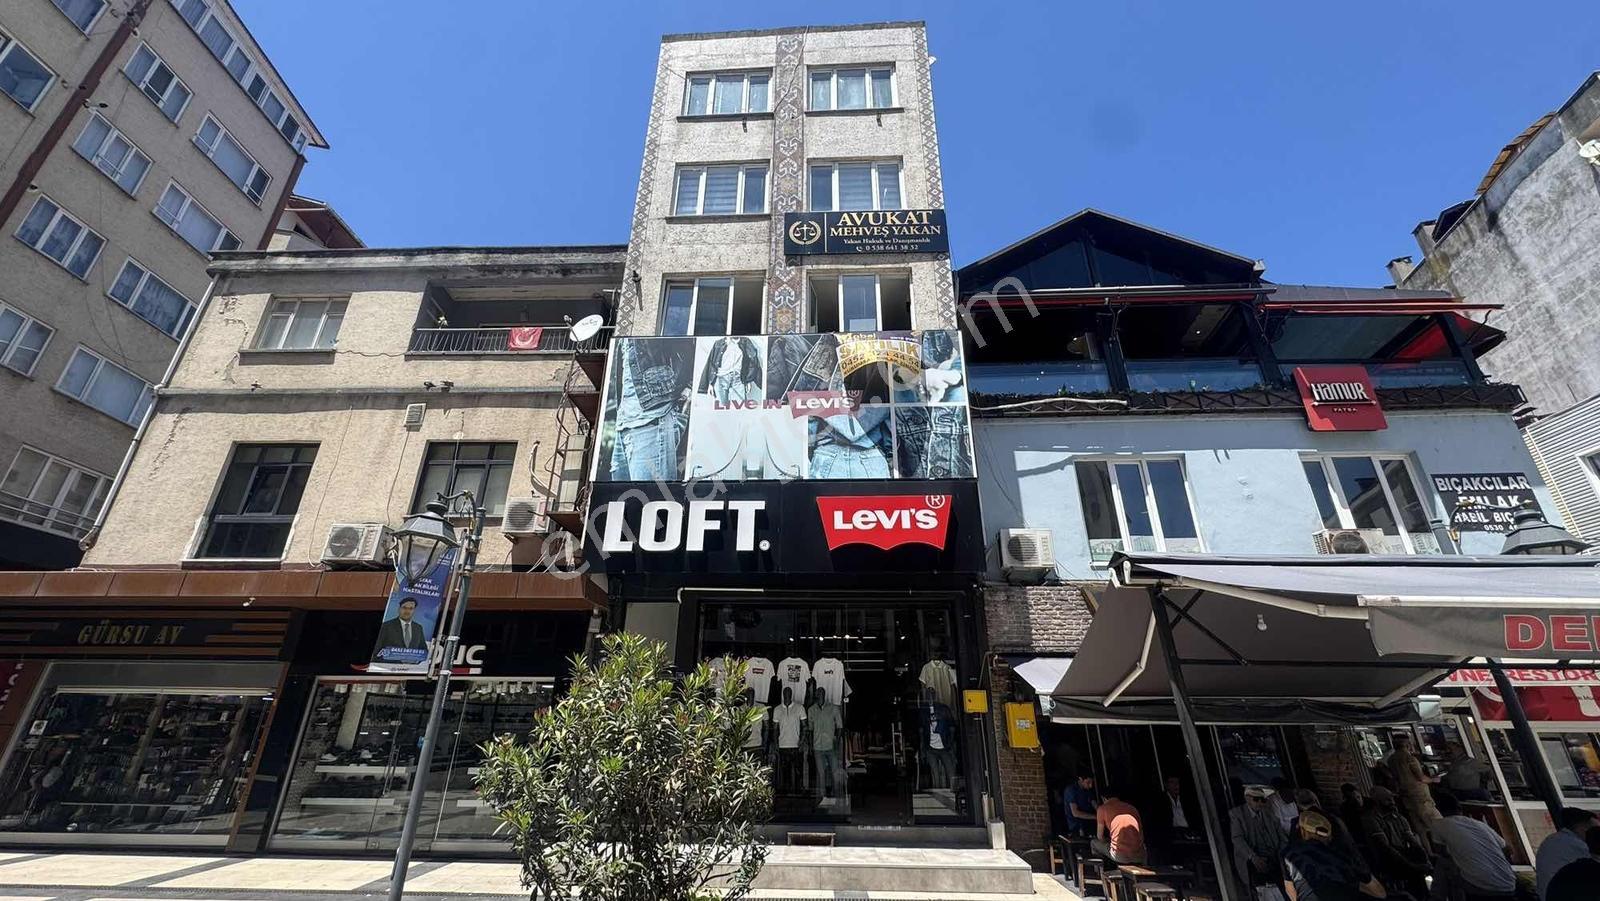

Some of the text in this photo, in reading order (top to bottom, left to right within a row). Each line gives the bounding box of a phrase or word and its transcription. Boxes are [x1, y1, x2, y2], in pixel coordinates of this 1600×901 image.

[837, 211, 932, 226] AVUKAT
[830, 225, 941, 238] MEHVEŞ YAKAN
[1434, 476, 1532, 495] BIÇAKCILAR
[78, 619, 150, 645] GÜRSU
[1503, 614, 1600, 651] DE
